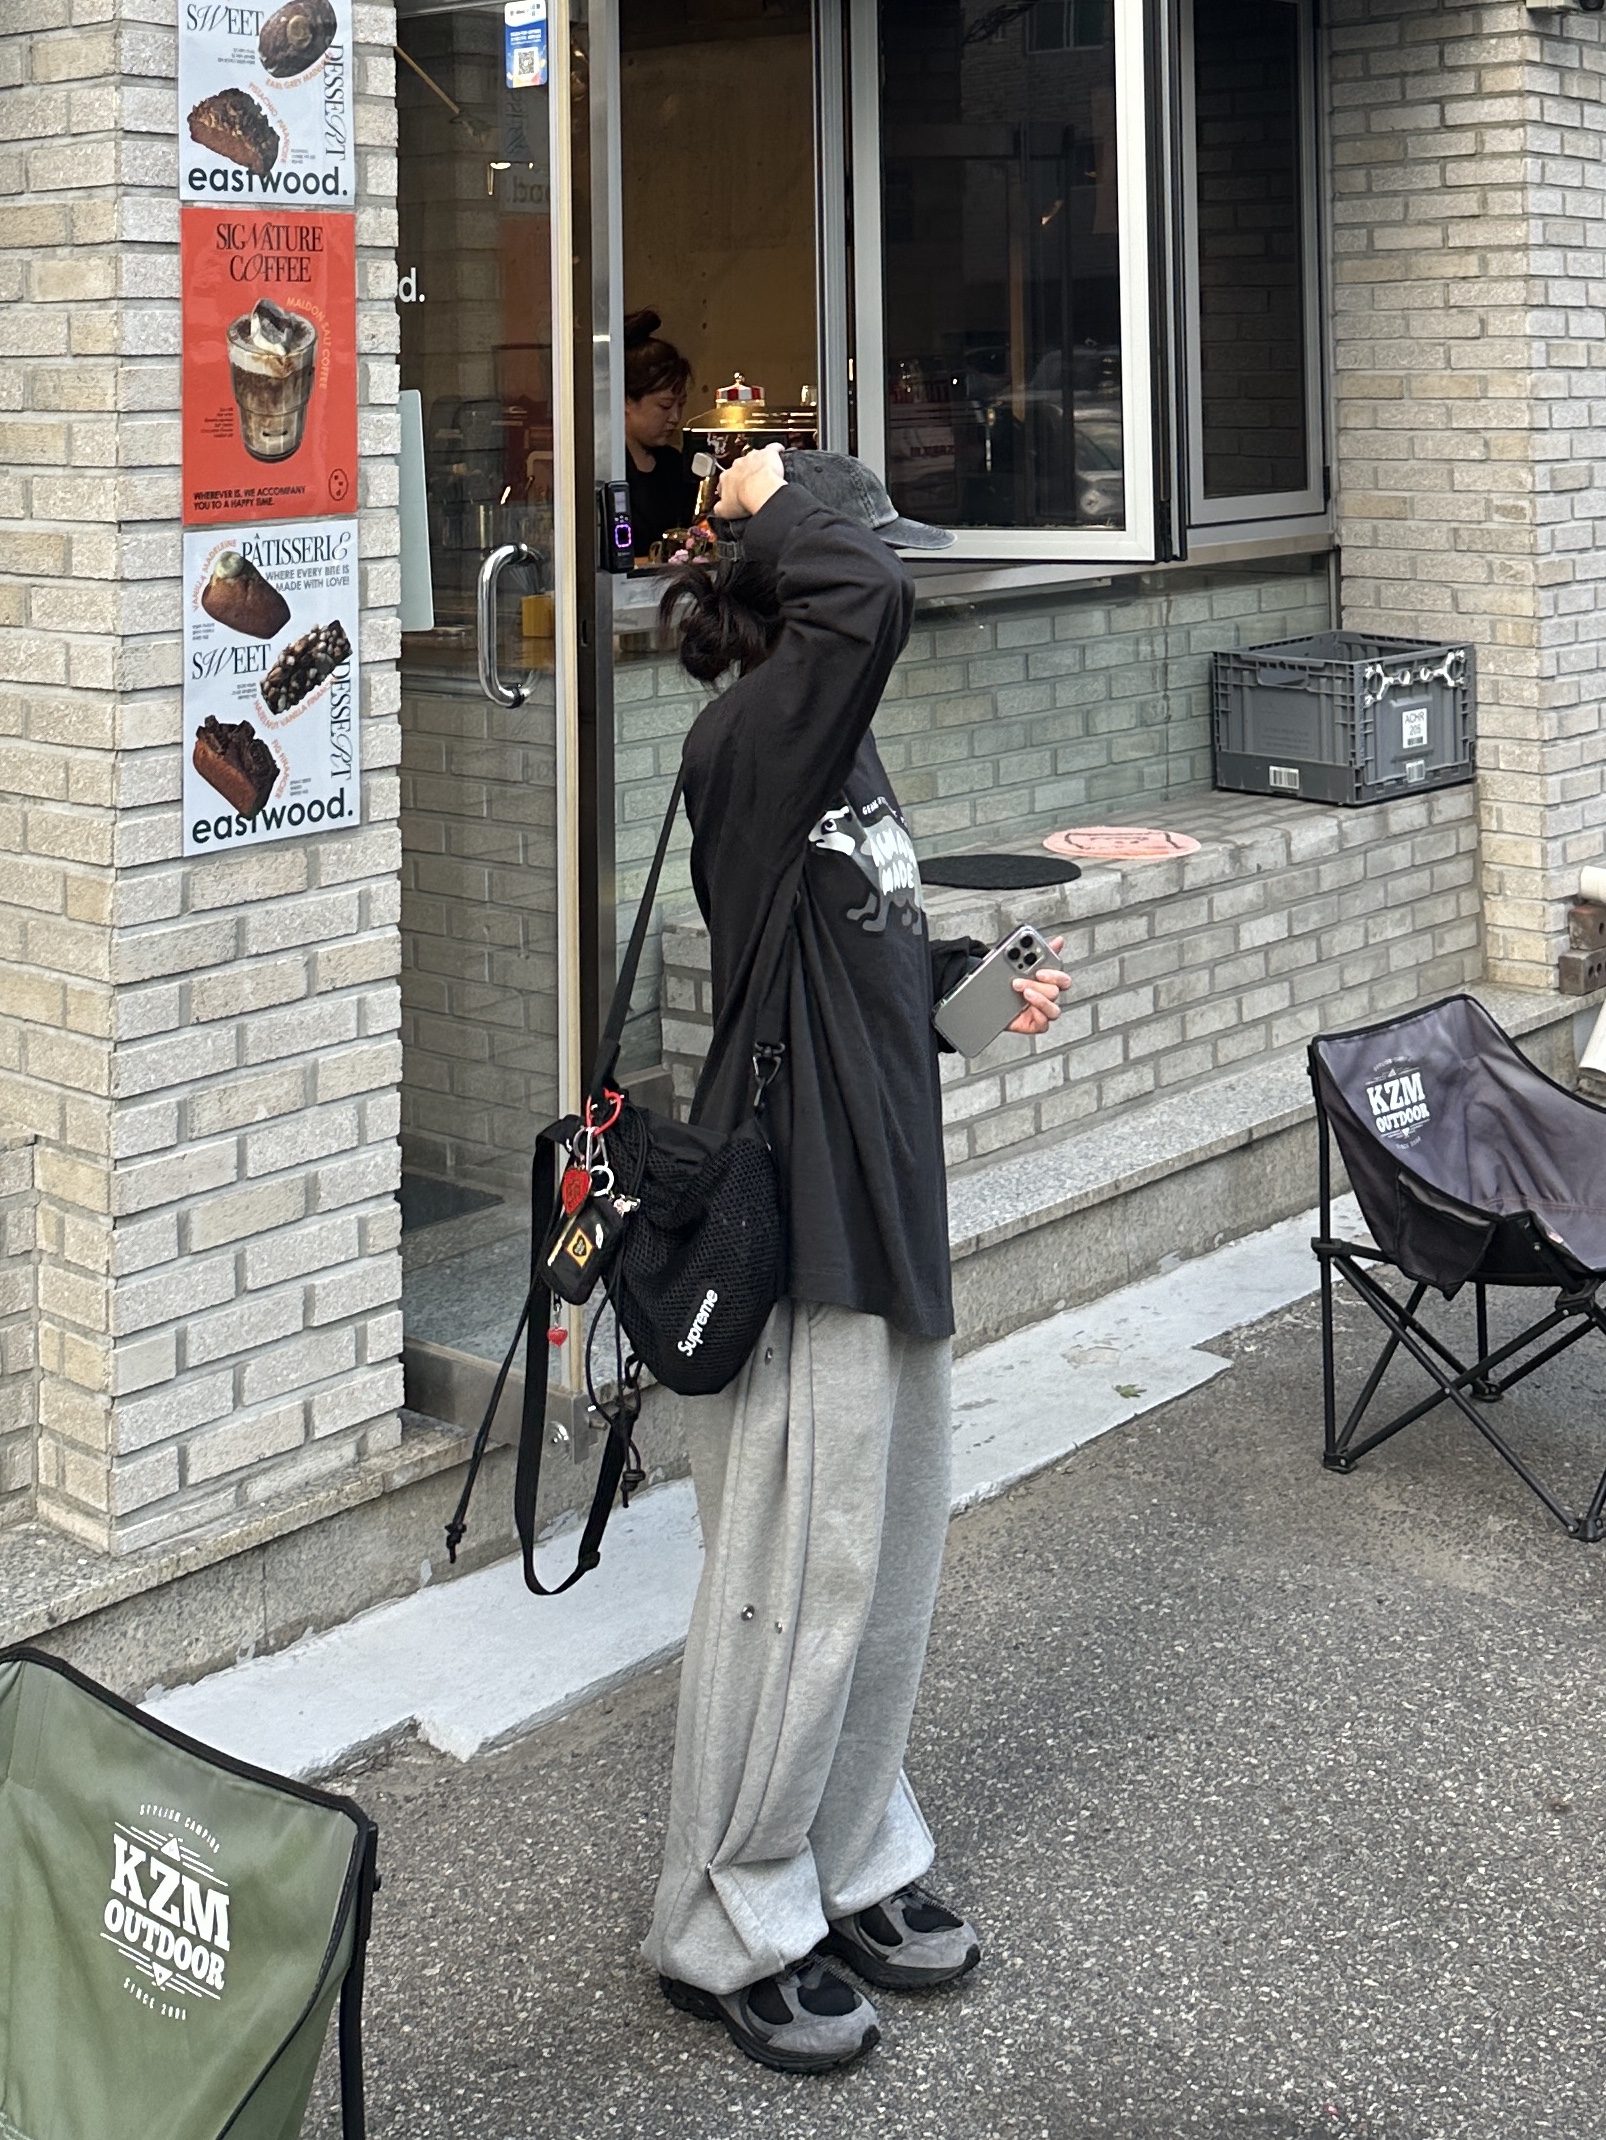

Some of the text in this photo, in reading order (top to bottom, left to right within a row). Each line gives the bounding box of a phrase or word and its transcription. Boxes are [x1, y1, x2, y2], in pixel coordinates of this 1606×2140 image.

[186, 4, 264, 37] SWEET
[324, 44, 347, 161] DESSERT
[188, 166, 348, 197] eastwood.
[216, 222, 324, 252] SIGNATURE
[229, 253, 312, 283] COFFEE
[286, 297, 331, 389] MALDON SALT COFFEE
[193, 489, 233, 501] WHEREVER
[244, 488, 256, 498] WE
[257, 485, 306, 497] ACCOMPANY
[194, 500, 211, 511] YOU
[212, 500, 222, 510] TO
[223, 499, 230, 509] A
[231, 498, 254, 508] HAPPY
[192, 575, 207, 613] VANILLA
[202, 538, 238, 573] MADELEINE
[266, 564, 350, 581] WHERE EVERY BITE IS
[276, 576, 350, 592] MADE WITH LOVE!
[191, 643, 272, 681] SWEET
[330, 660, 353, 782] DESSERT
[191, 787, 354, 845] eastwood.
[881, 859, 915, 896] MADE
[1366, 1071, 1426, 1116] KZM
[1375, 1102, 1431, 1133] OUTDOOR
[677, 1288, 719, 1357] Supreme
[139, 1804, 221, 1855] STYLISH CAMPING
[110, 1833, 231, 1952] KZM
[103, 1898, 226, 1991] OUTDOOR
[123, 1976, 156, 2009] SINCE
